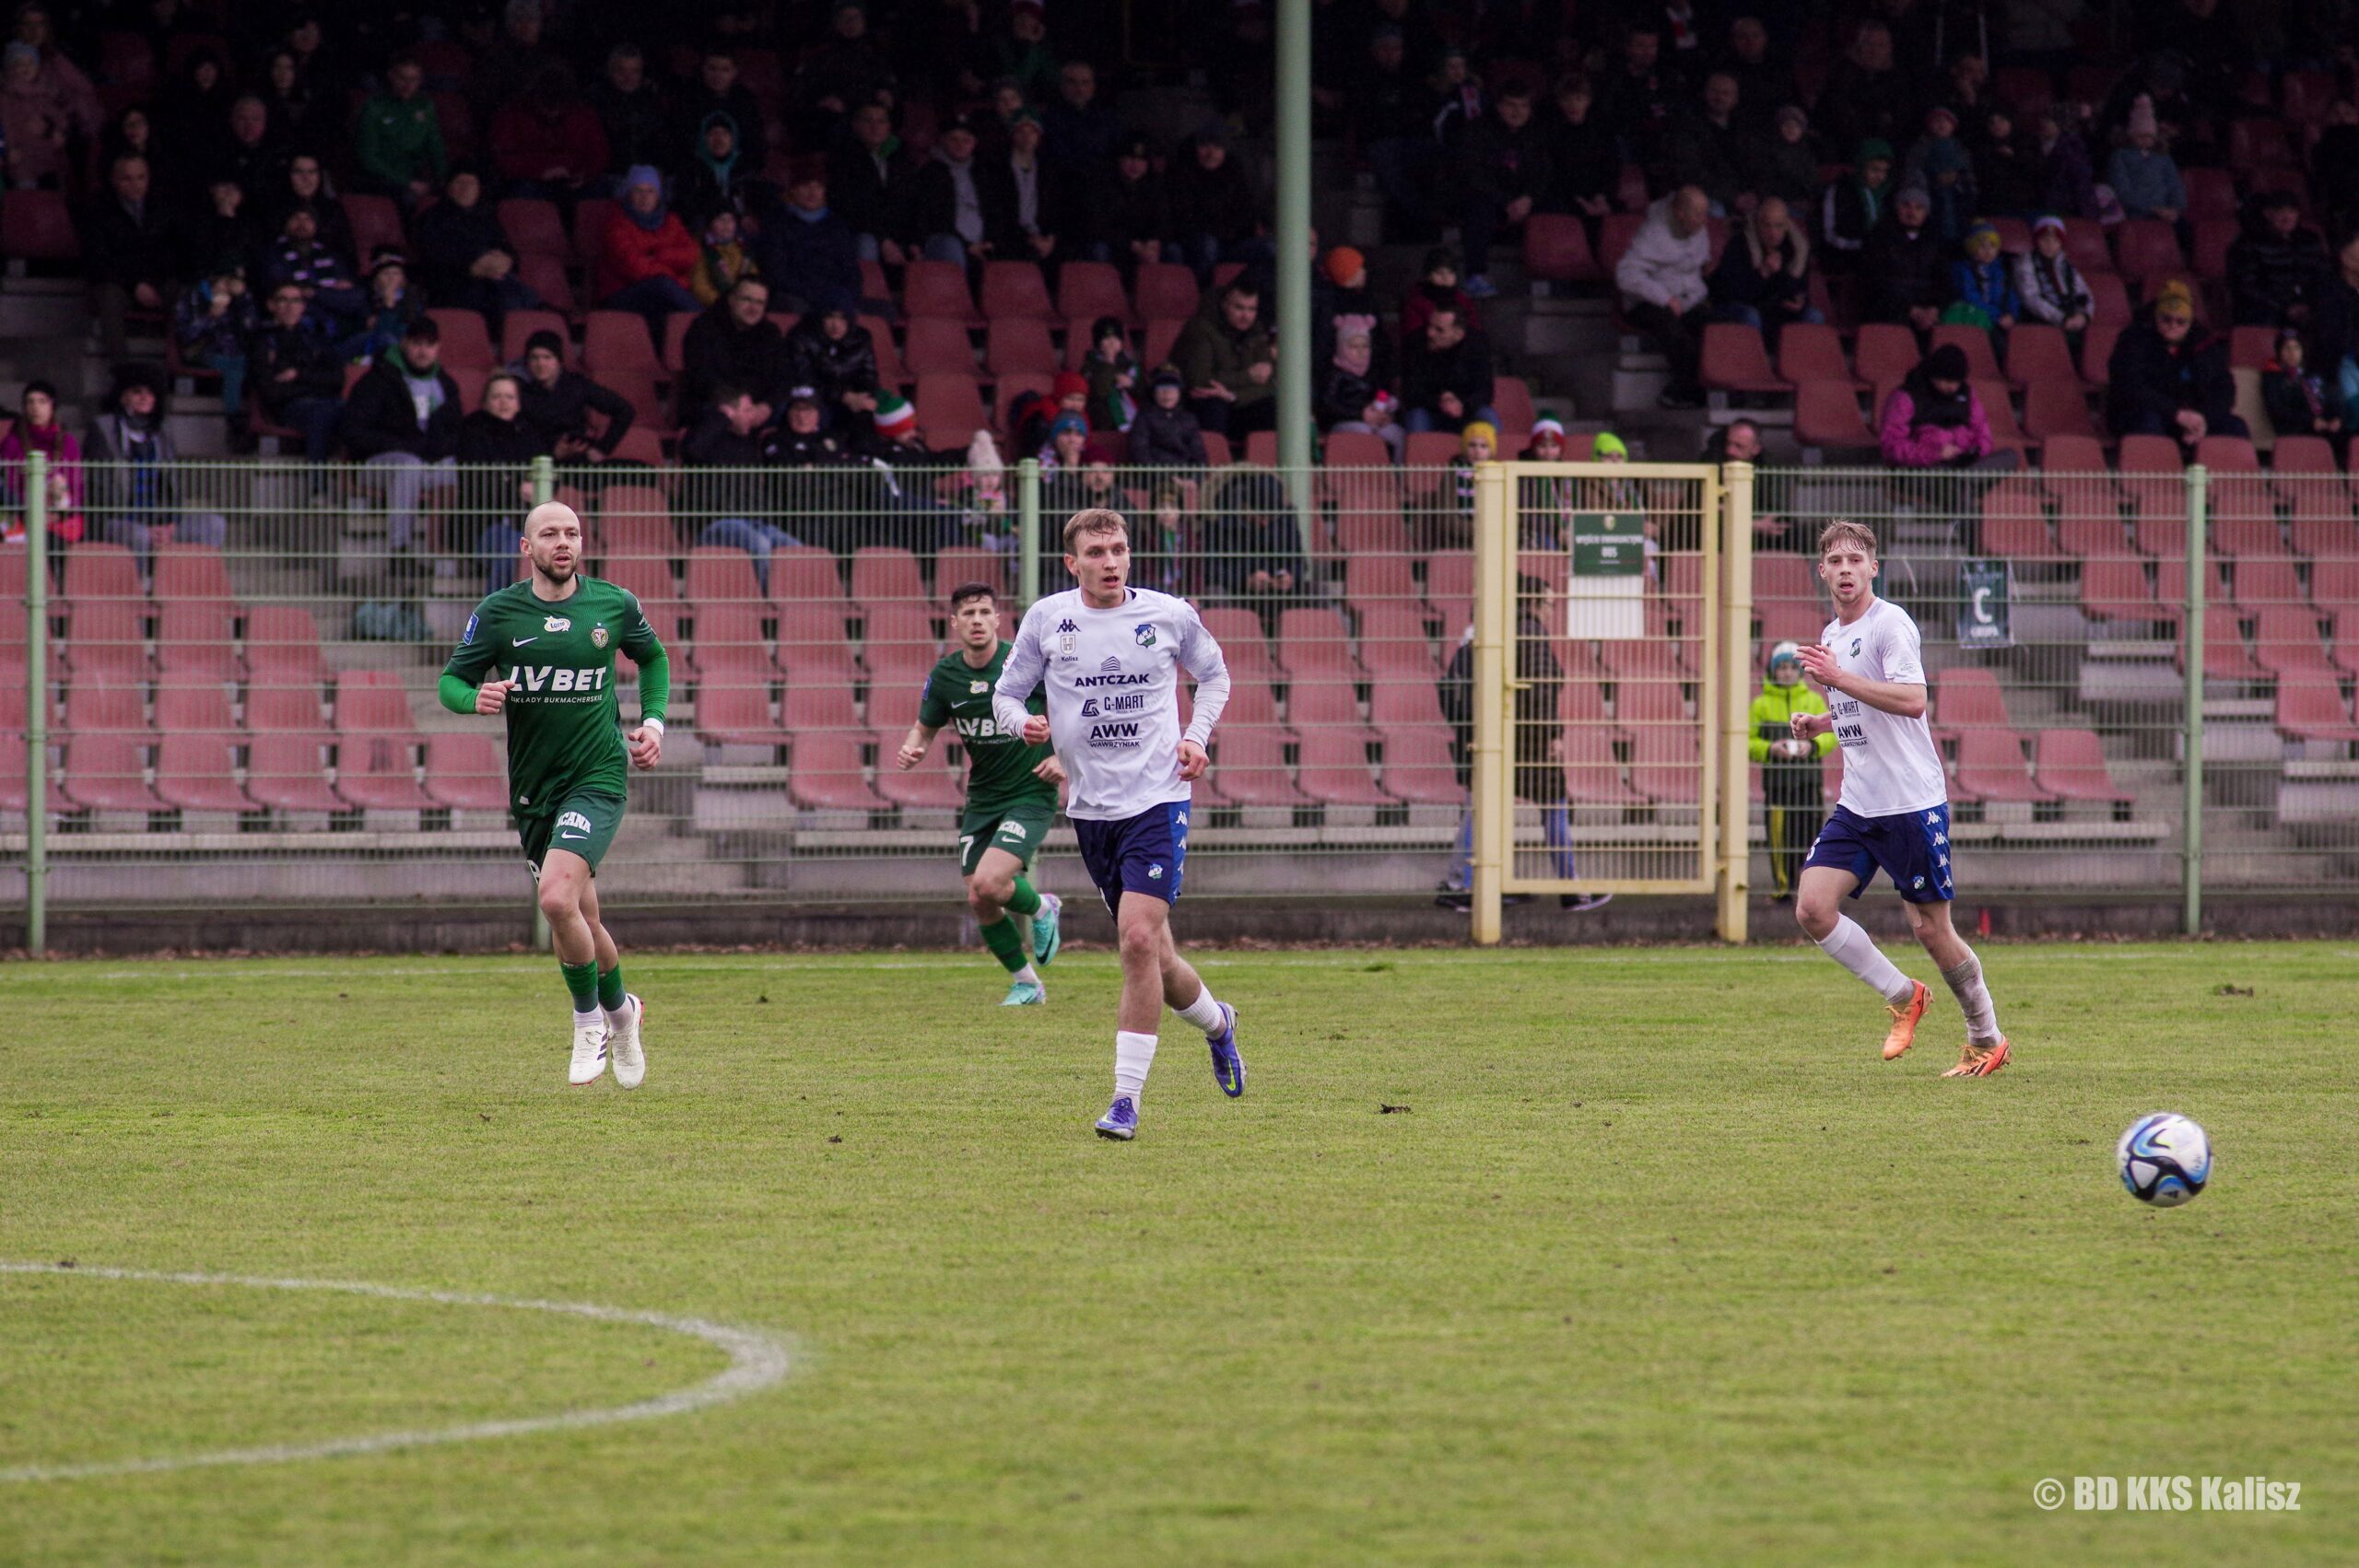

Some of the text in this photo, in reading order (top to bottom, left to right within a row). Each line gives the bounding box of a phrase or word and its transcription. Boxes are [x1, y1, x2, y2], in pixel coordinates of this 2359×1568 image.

[1974, 587, 1992, 623] C
[1074, 673, 1150, 686] ANTCZAK
[545, 695, 603, 703] BUKMACHERSKIE
[1104, 695, 1144, 710] G-MART
[1090, 723, 1139, 739] AWW
[1837, 724, 1862, 739] AWW
[960, 836, 974, 866] 7
